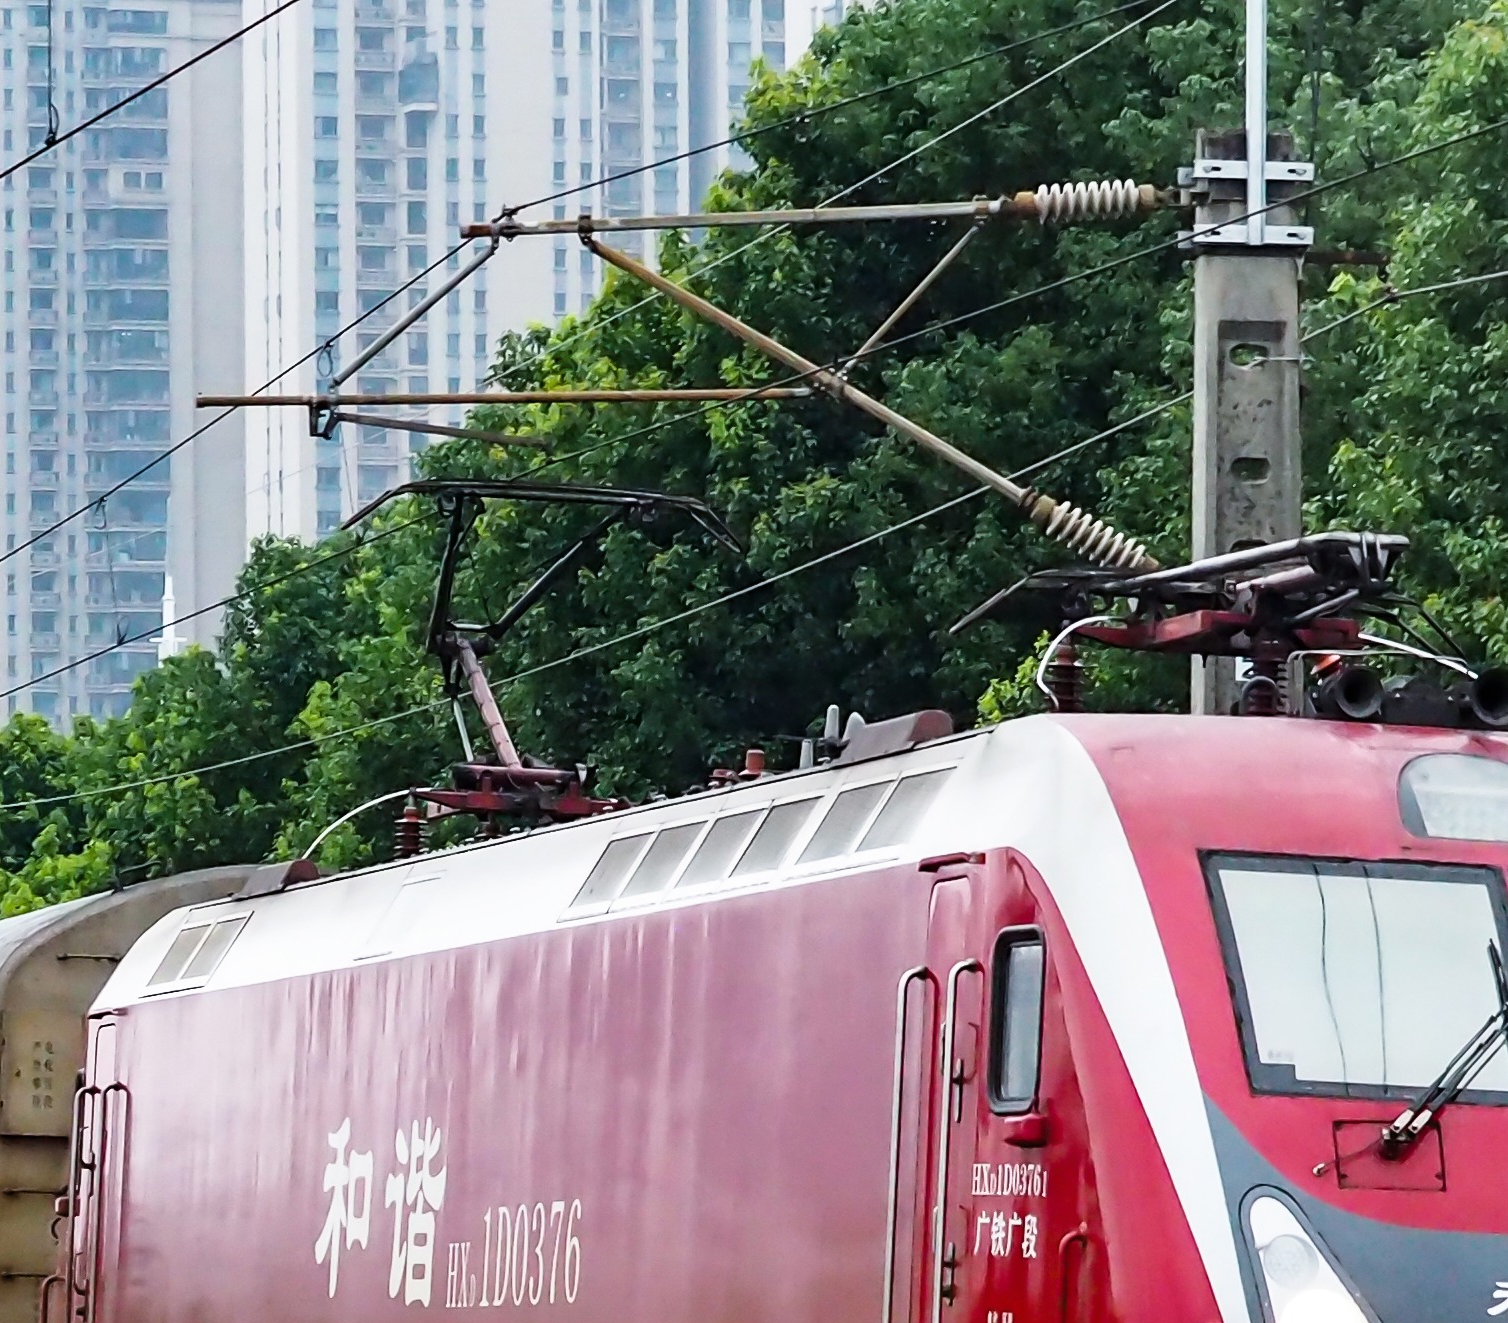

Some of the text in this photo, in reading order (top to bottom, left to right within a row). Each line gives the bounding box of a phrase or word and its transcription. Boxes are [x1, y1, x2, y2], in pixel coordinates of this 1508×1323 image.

[315, 1116, 582, 1308] 和谐 HXD1D0376
[973, 1210, 1038, 1258] 广铁广段
